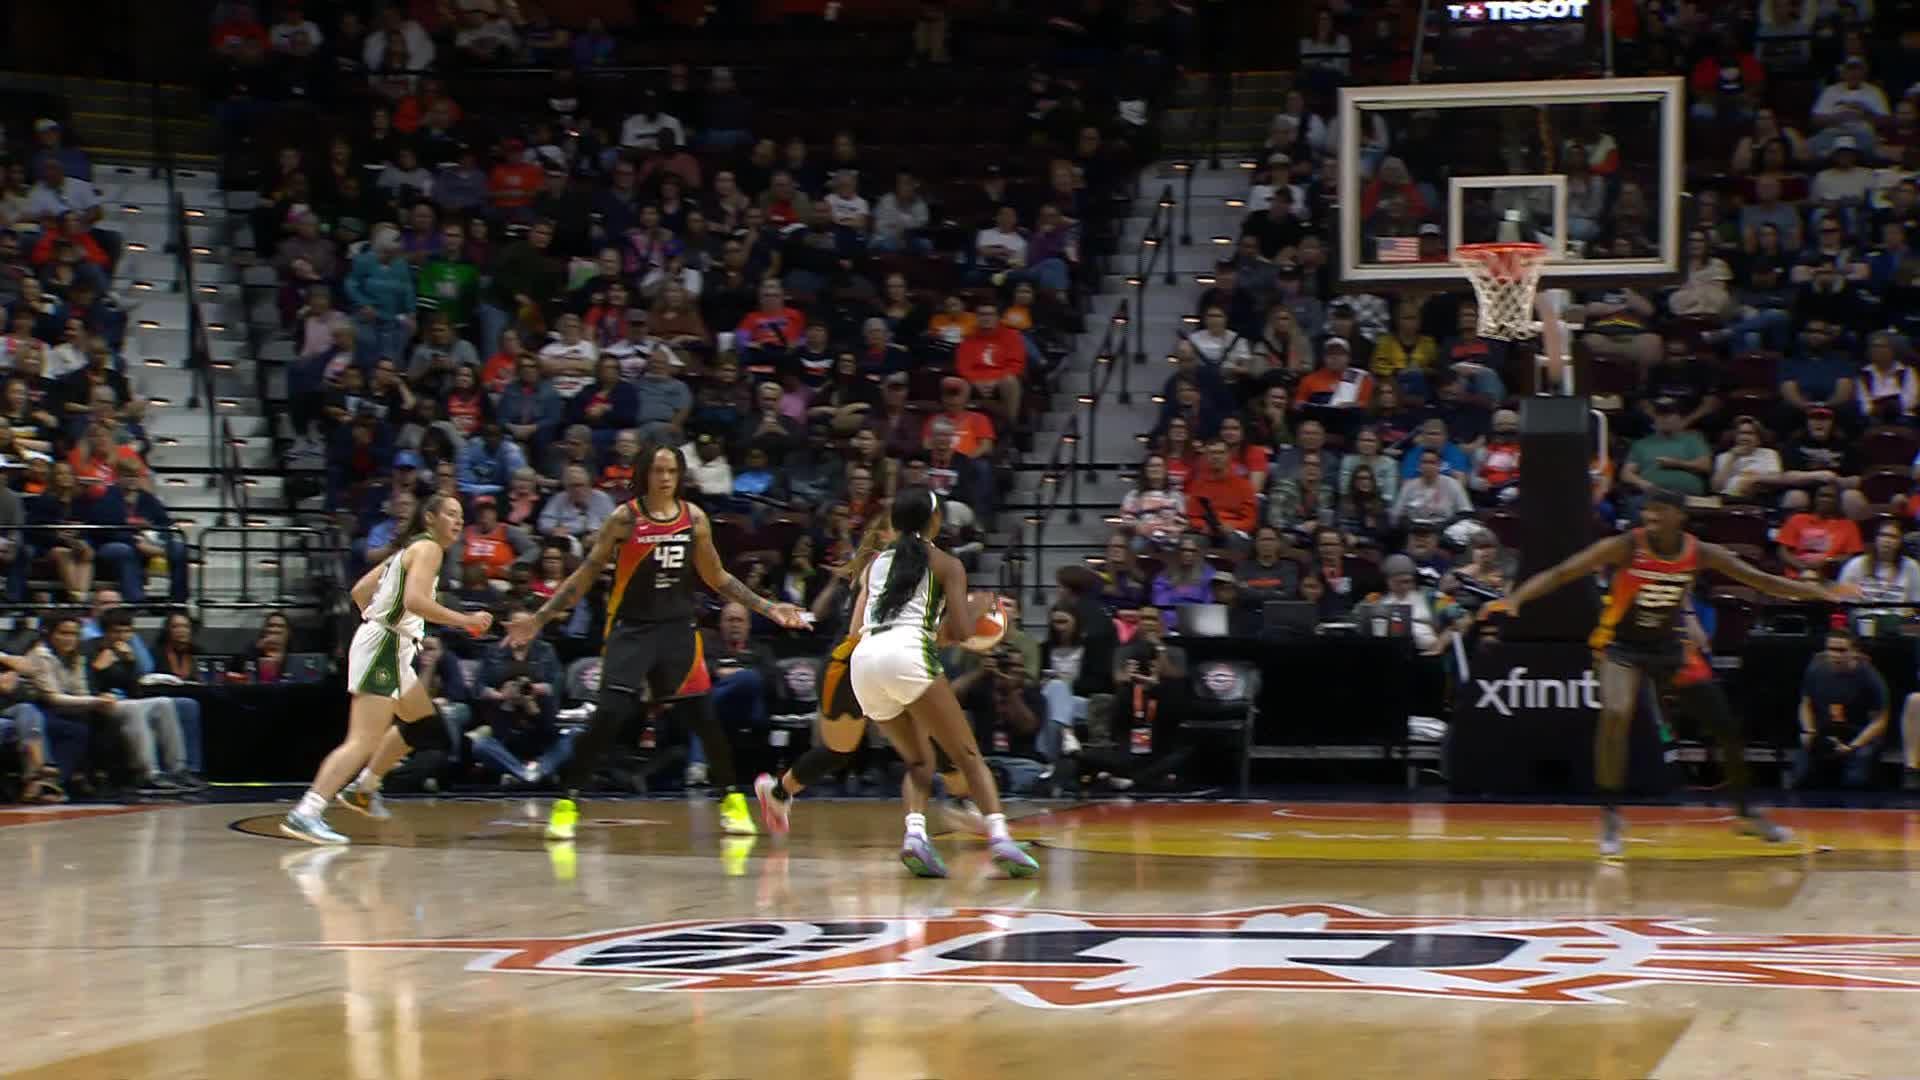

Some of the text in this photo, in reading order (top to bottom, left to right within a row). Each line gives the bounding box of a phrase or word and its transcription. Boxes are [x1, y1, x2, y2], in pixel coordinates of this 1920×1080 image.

[1484, 0, 1589, 20] TISSOT
[654, 545, 685, 568] 42
[1475, 666, 1603, 716] xfinit
